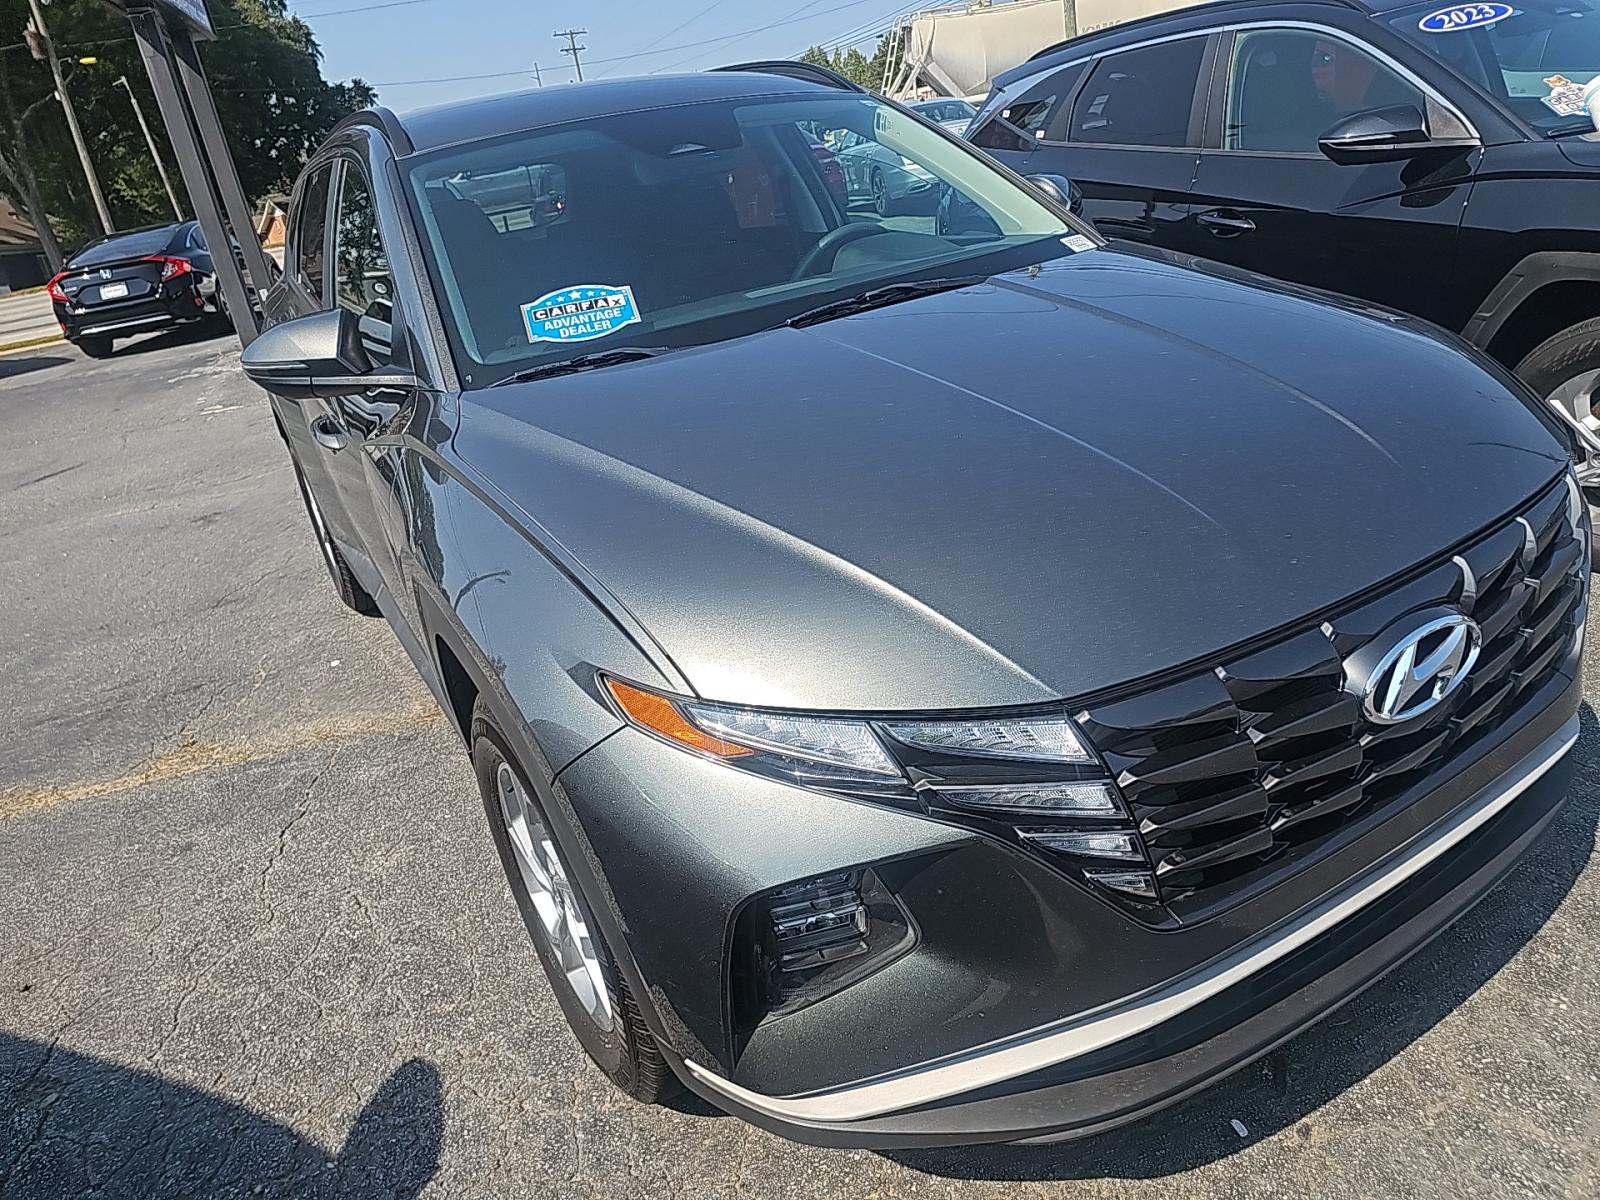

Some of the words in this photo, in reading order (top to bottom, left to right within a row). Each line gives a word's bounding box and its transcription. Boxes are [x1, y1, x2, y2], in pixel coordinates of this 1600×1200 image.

[1435, 5, 1495, 28] 2023
[534, 297, 623, 319] CARFAX
[544, 308, 622, 331] ADVANTAGE
[560, 320, 612, 338] DEALER
